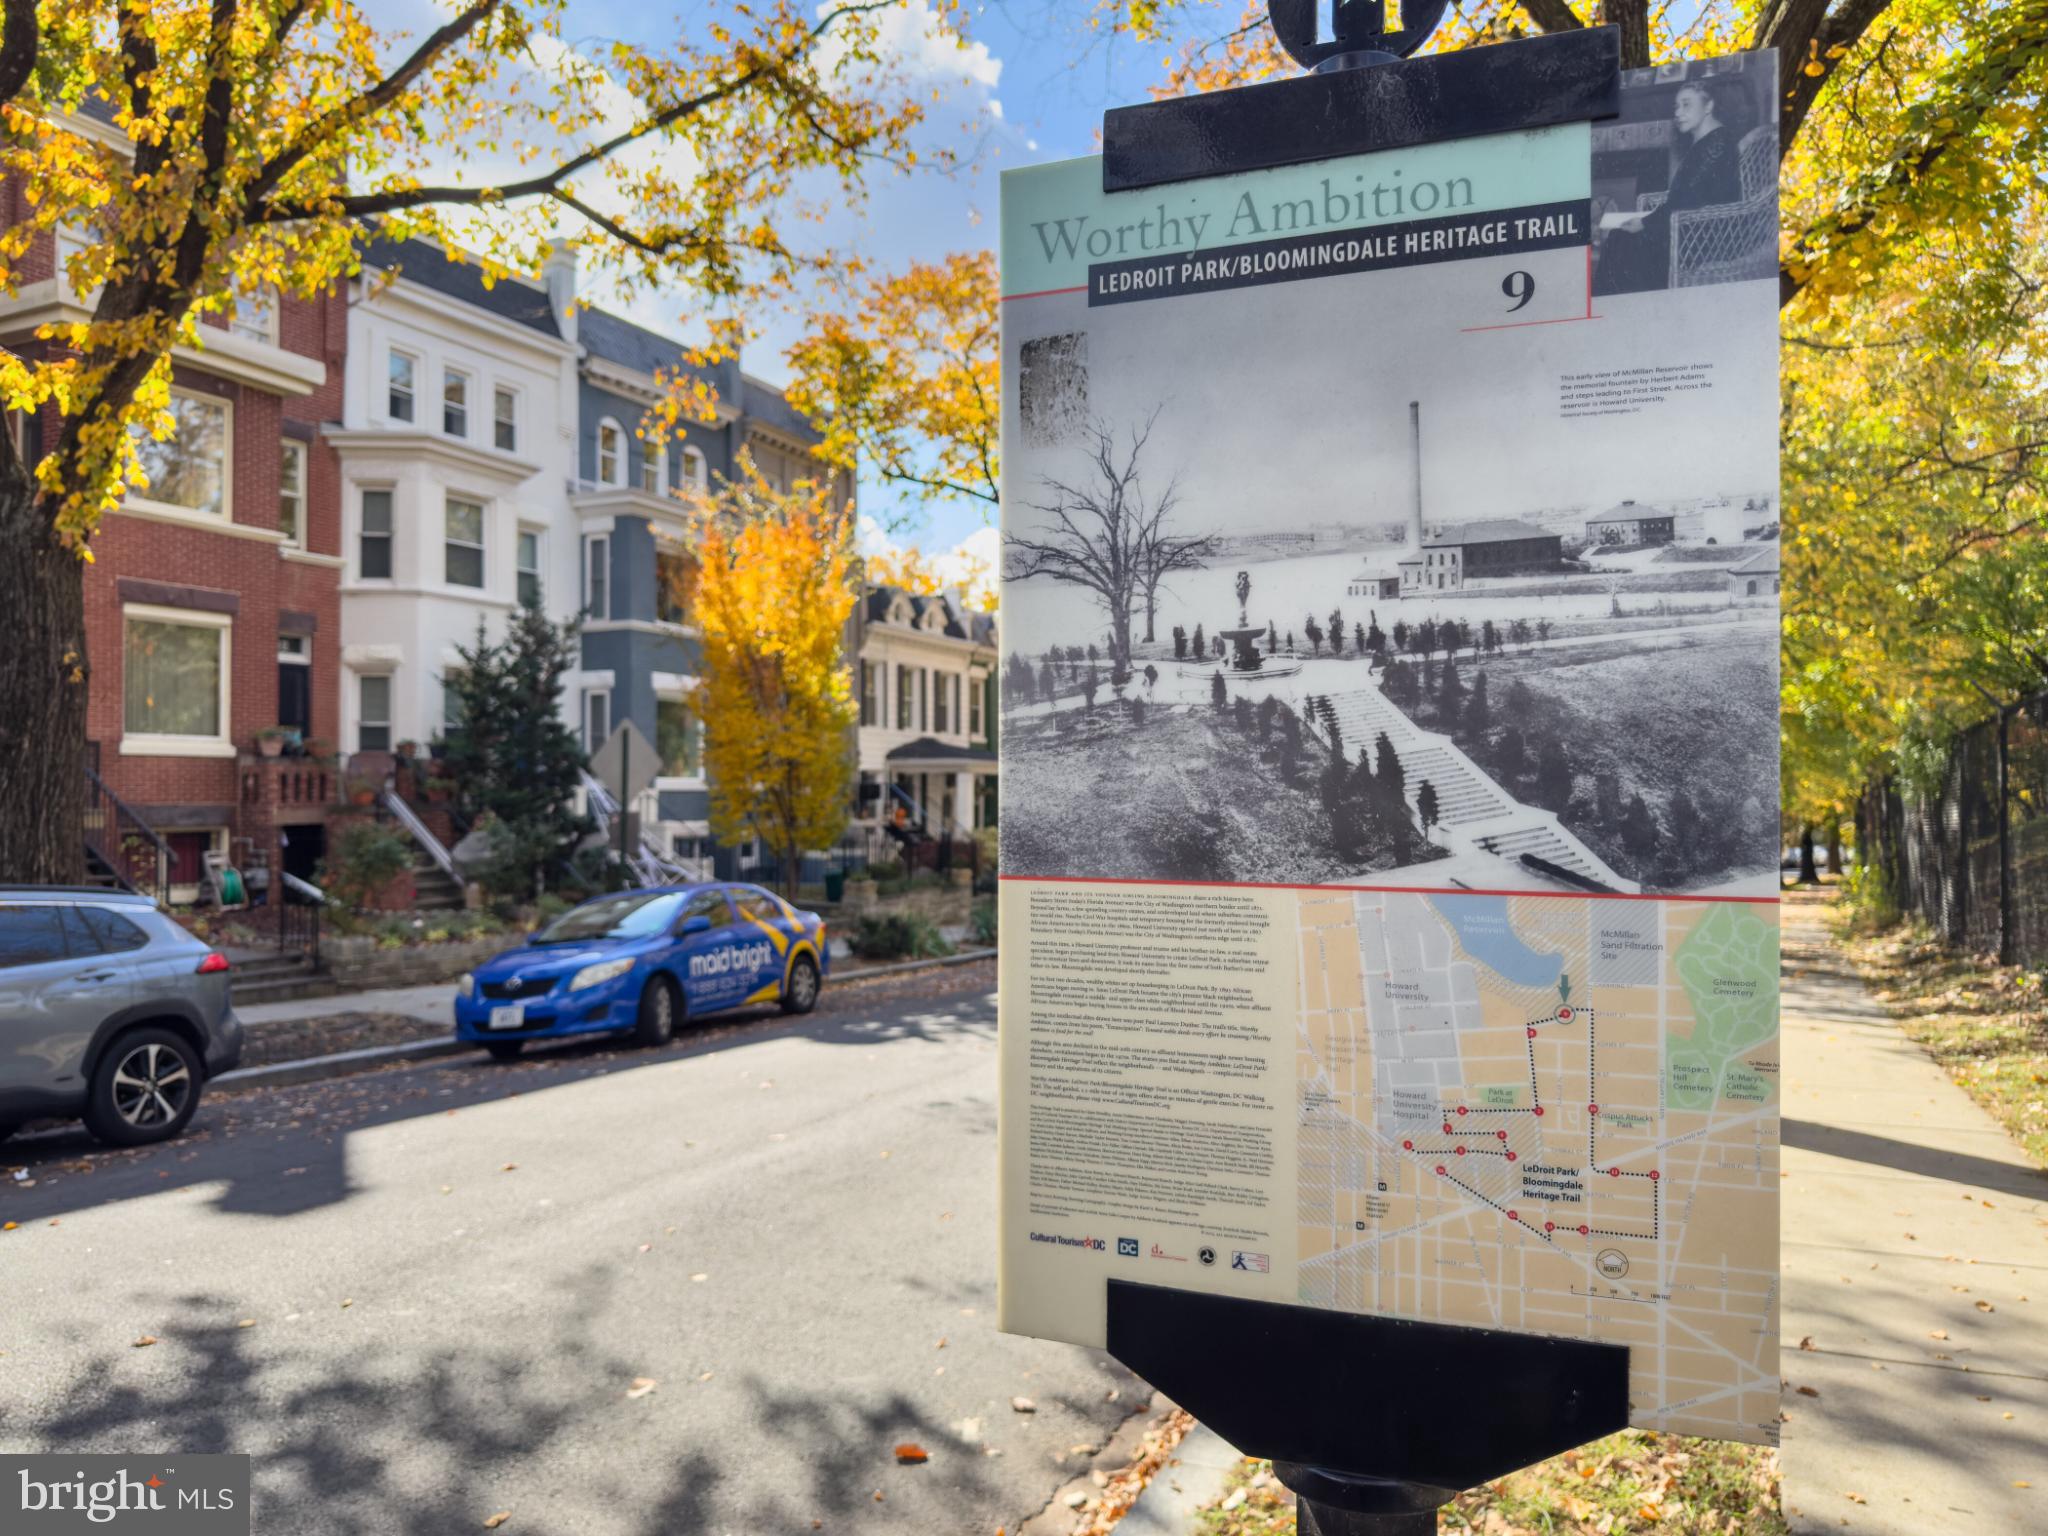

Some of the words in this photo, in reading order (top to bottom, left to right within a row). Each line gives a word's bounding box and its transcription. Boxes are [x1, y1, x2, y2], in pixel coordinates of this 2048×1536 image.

[1030, 204, 1211, 264] Worthy
[1225, 169, 1475, 237] Ambition
[1099, 266, 1175, 294] LEDROIT
[1181, 236, 1397, 282] PARK/BLOOMINGDALE
[1404, 222, 1508, 254] HERITAGE
[1514, 213, 1578, 241] TRAIL
[1501, 270, 1536, 313] 9
[1656, 366, 1688, 374] Reservoir
[1574, 382, 1607, 390] memorial
[1608, 379, 1638, 387] fountain
[1576, 392, 1594, 400] steps
[1596, 390, 1622, 398] leading
[1601, 930, 1640, 939] McMillan
[1601, 940, 1622, 949] Sand
[1625, 942, 1663, 951] Filtration
[689, 946, 730, 976] maid
[731, 941, 772, 973] bright
[1601, 952, 1617, 960] Site
[1385, 982, 1419, 990] Howard
[1713, 979, 1756, 988] Glenwood
[1385, 992, 1429, 1001] University
[1713, 988, 1753, 997] Cemetery
[1673, 1065, 1709, 1073] Prospect
[1739, 1074, 1764, 1082] Mary's
[1488, 1088, 1504, 1096] Park
[1673, 1083, 1713, 1093] Cemetery
[1726, 1083, 1759, 1091] Catholic
[1393, 1090, 1426, 1100] Howard
[1726, 1092, 1764, 1102] Cemetery
[1393, 1100, 1437, 1111] University
[1393, 1111, 1429, 1120] Hospital
[1523, 1164, 1554, 1175] LeDroit
[1557, 1167, 1580, 1177] Park/
[1523, 1177, 1583, 1190] Bloomingdale
[1523, 1190, 1560, 1202] Heritage
[1562, 1194, 1581, 1203] Trail
[1030, 1232, 1056, 1243] Cultural
[1058, 1236, 1084, 1247] Tourism
[1093, 1239, 1105, 1250] DC
[1119, 1242, 1137, 1254] DC
